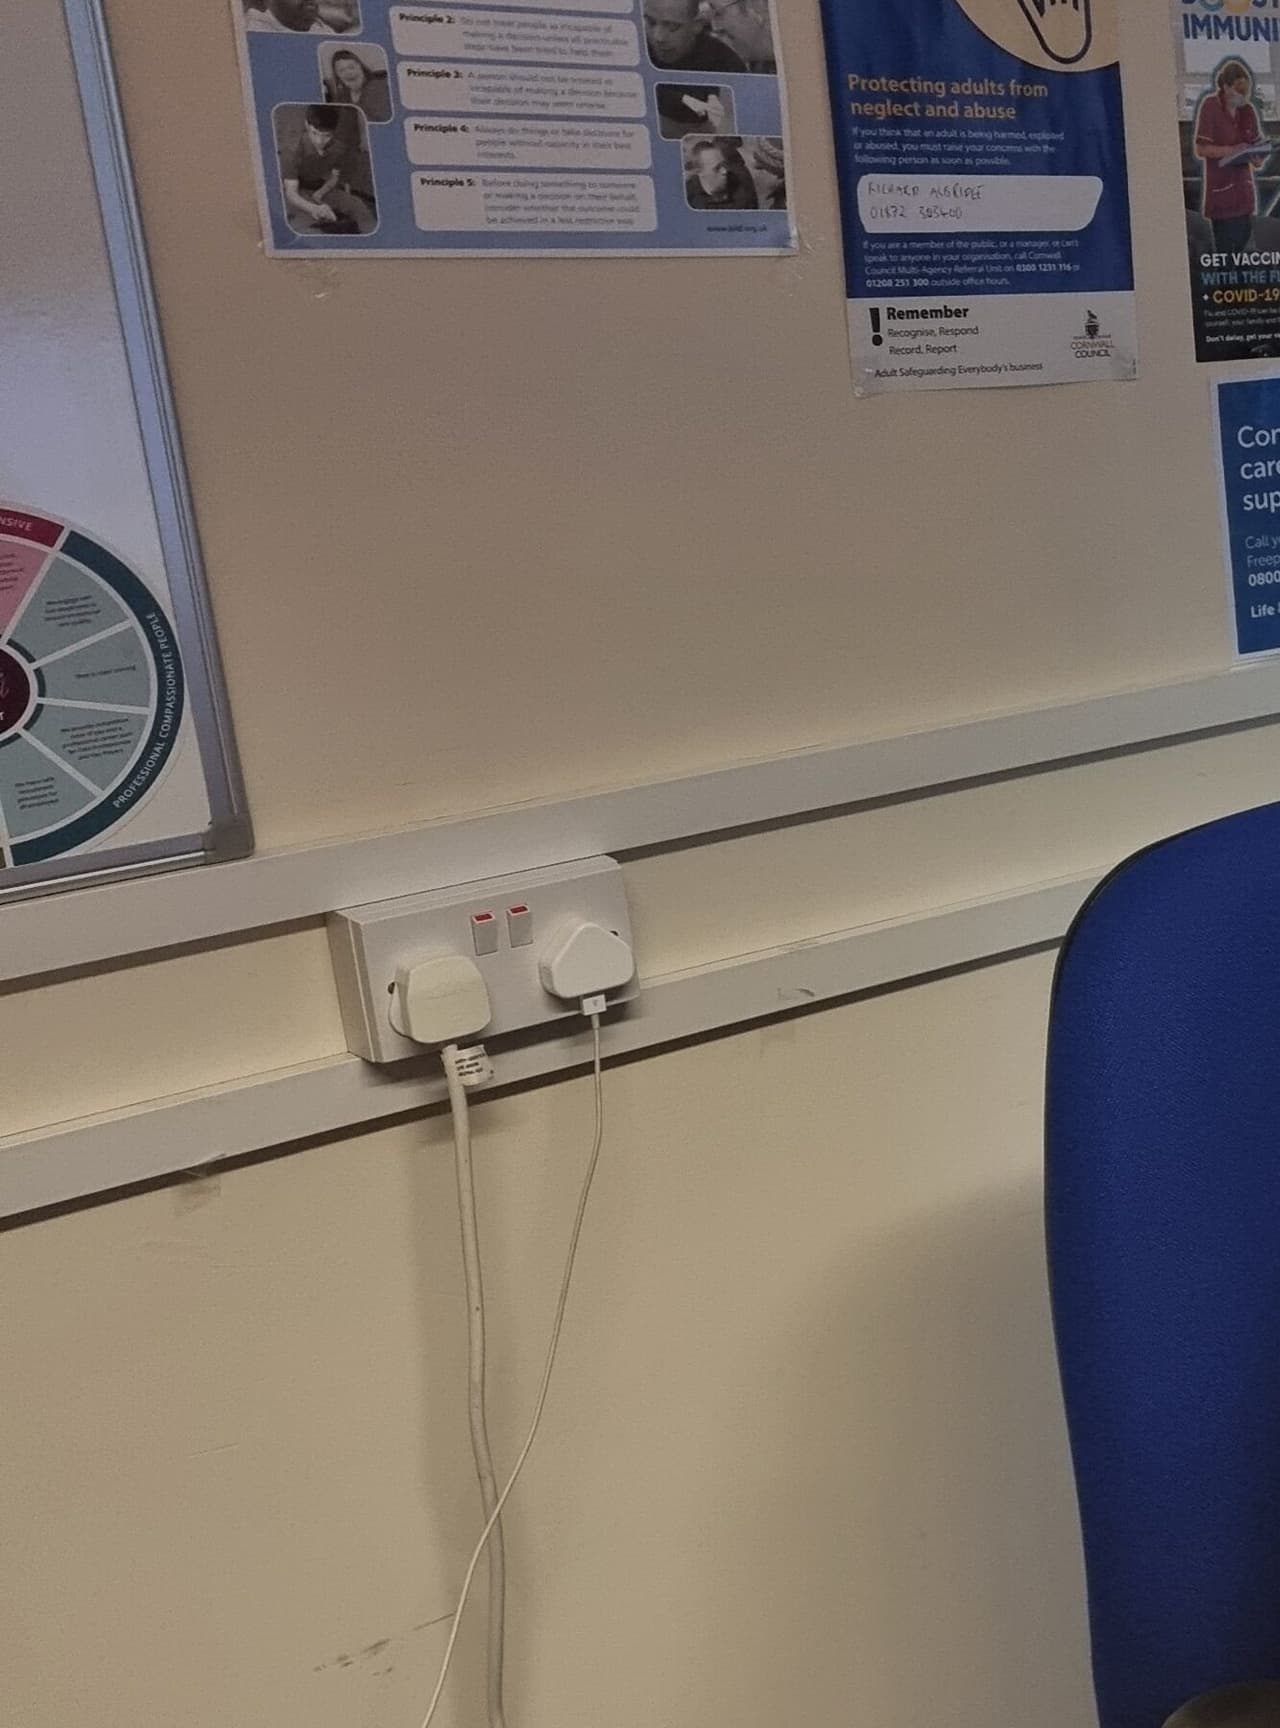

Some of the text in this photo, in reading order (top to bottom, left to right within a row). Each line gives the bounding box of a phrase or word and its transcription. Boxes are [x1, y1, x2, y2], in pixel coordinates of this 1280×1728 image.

[400, 12, 444, 23] Principle
[408, 68, 451, 79] Principle
[848, 73, 1048, 98] Protecting adults from
[851, 99, 1017, 120] neglect and abuse
[414, 123, 458, 133] Principle
[420, 177, 464, 187] Principle
[1200, 253, 1227, 267] GET
[1201, 271, 1237, 285] WITH
[1242, 270, 1266, 284] THE
[1212, 288, 1279, 303] COVID-19
[886, 305, 970, 320] Remember
[939, 326, 979, 338] Respond
[926, 344, 957, 356] Report
[1071, 341, 1115, 350] CORNWALL
[1076, 350, 1111, 358] COUNCIL
[875, 369, 897, 378] Adult
[899, 366, 956, 378] Safeguarding
[1010, 363, 1043, 372] business
[1245, 536, 1269, 549] Call
[1248, 570, 1280, 586] 0800
[1250, 604, 1275, 618] Life
[112, 612, 176, 808] PROFESSIONAL COMPASSIONATE PEOPLE
